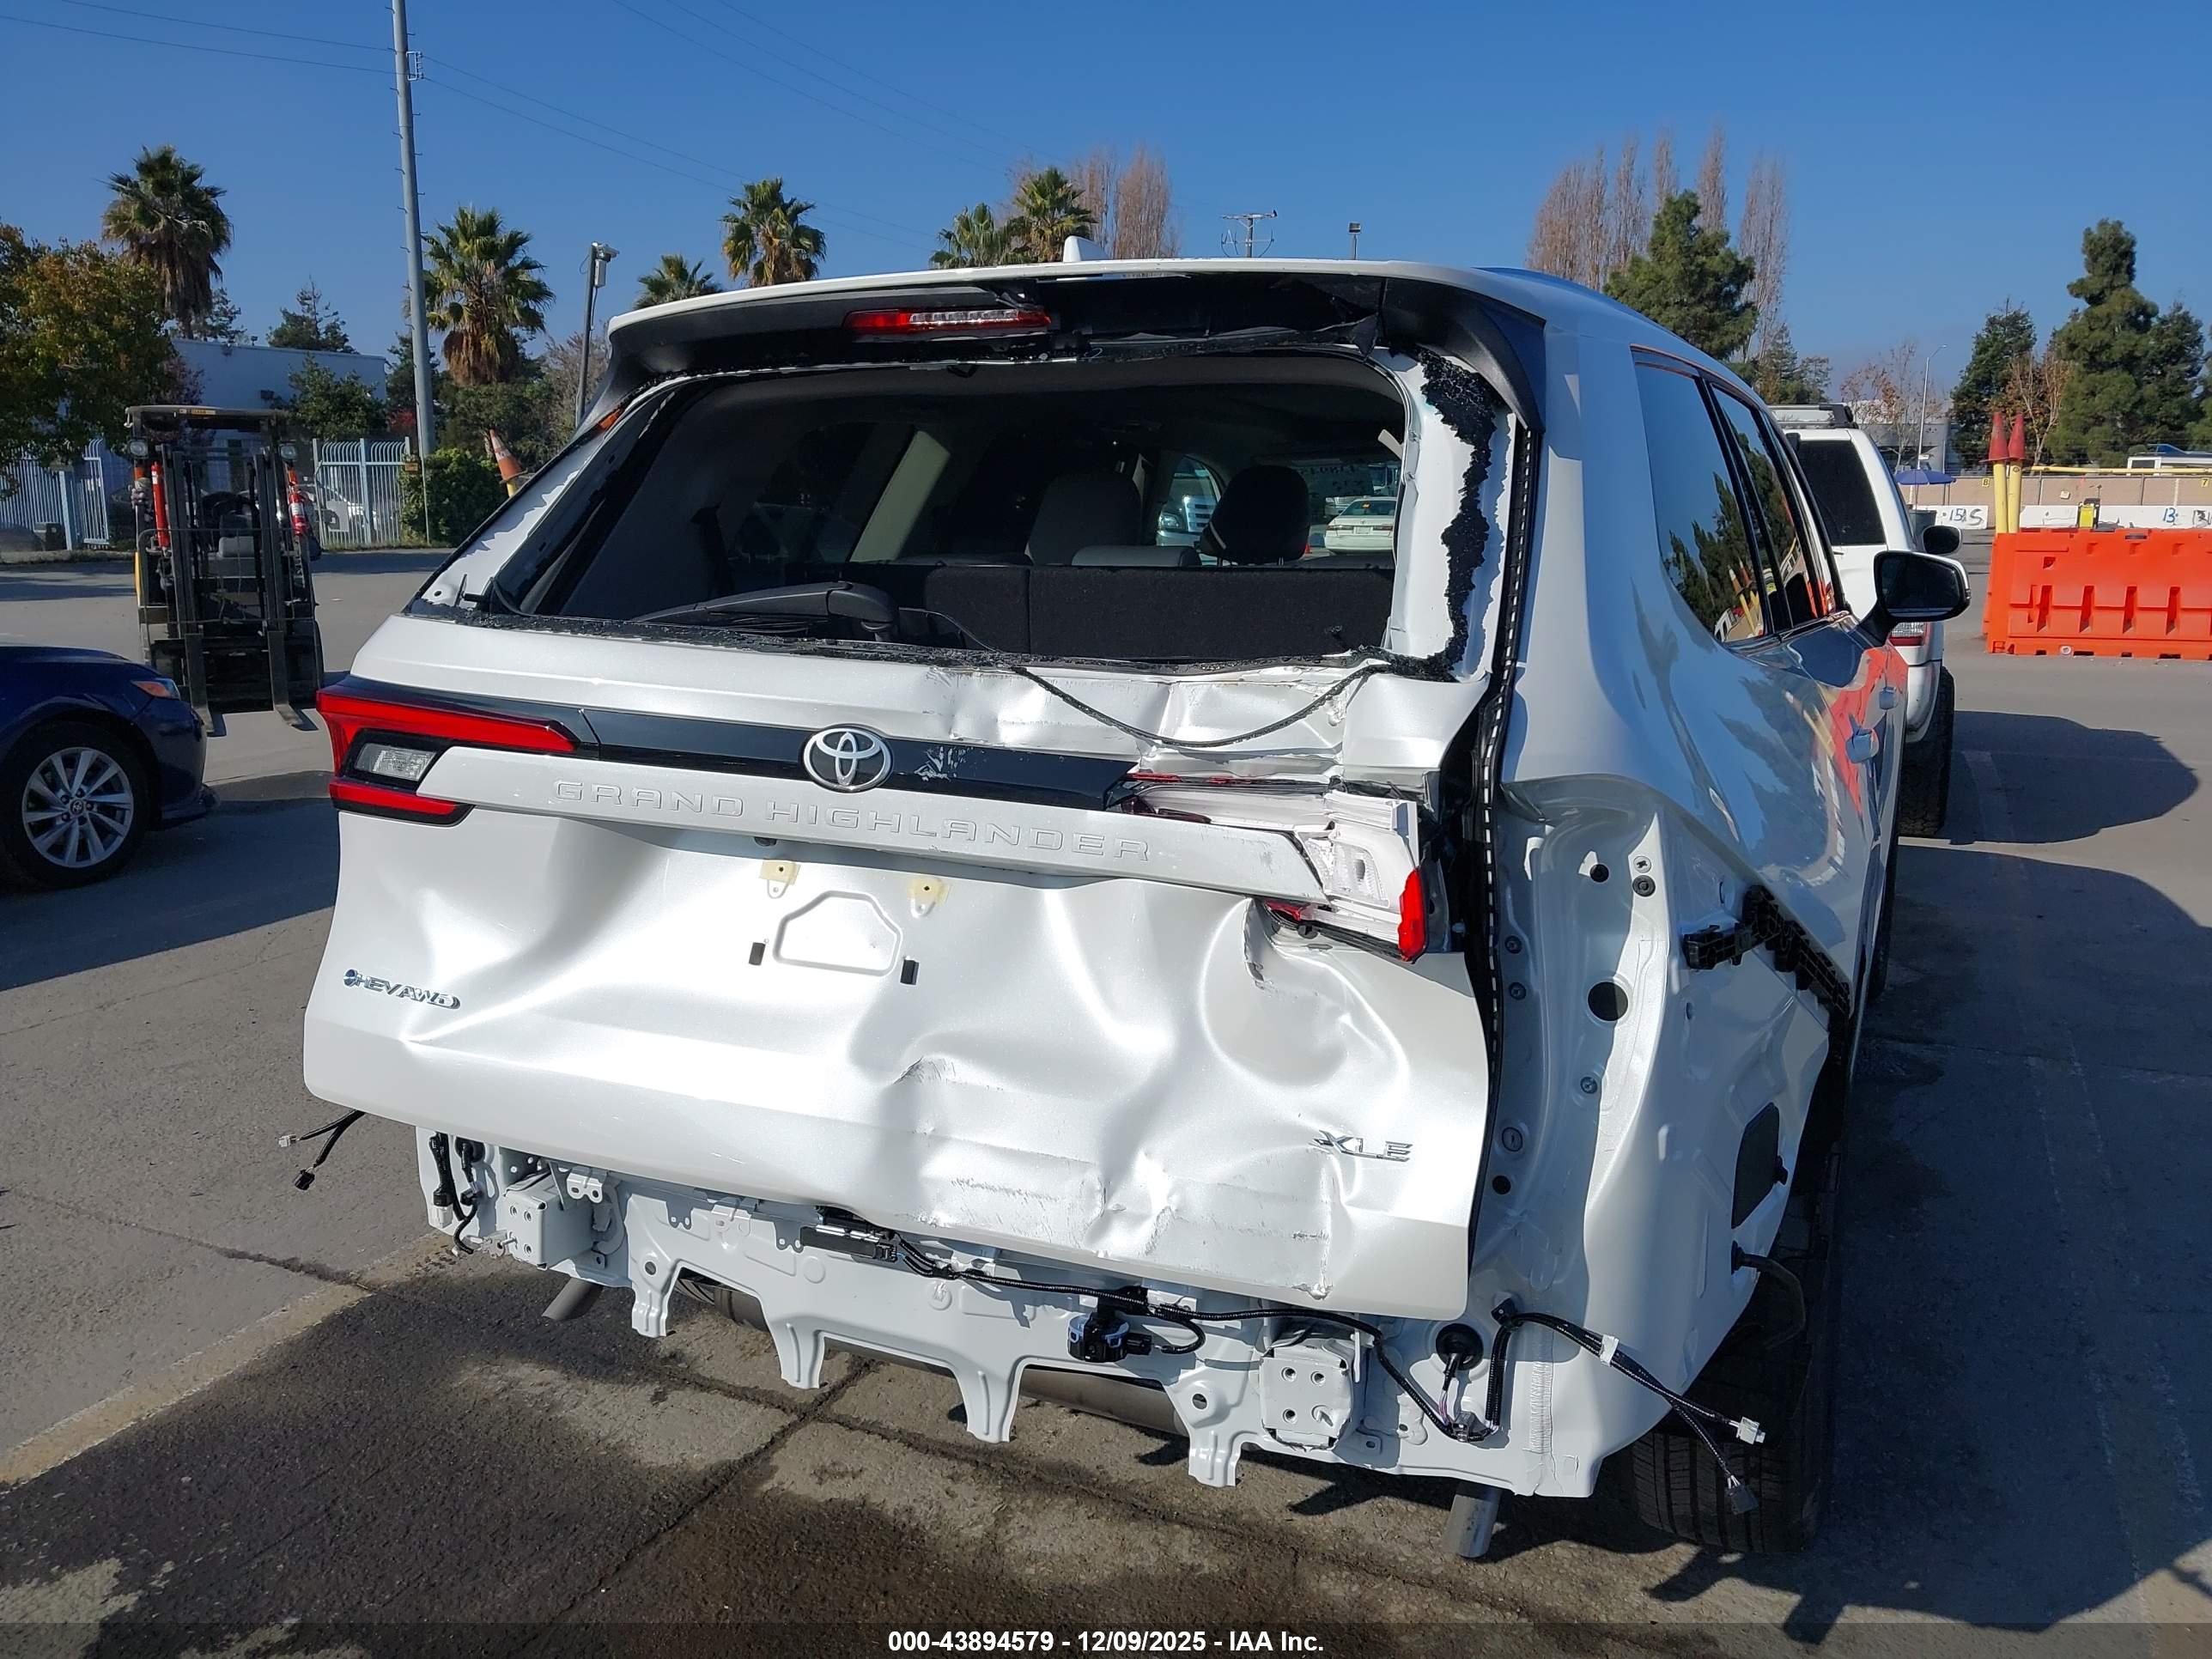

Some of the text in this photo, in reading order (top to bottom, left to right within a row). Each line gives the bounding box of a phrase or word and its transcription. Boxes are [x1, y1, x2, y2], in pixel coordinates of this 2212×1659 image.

[556, 781, 1149, 861] GRAND HIGHLANDER
[1313, 1129, 1413, 1163] XLE
